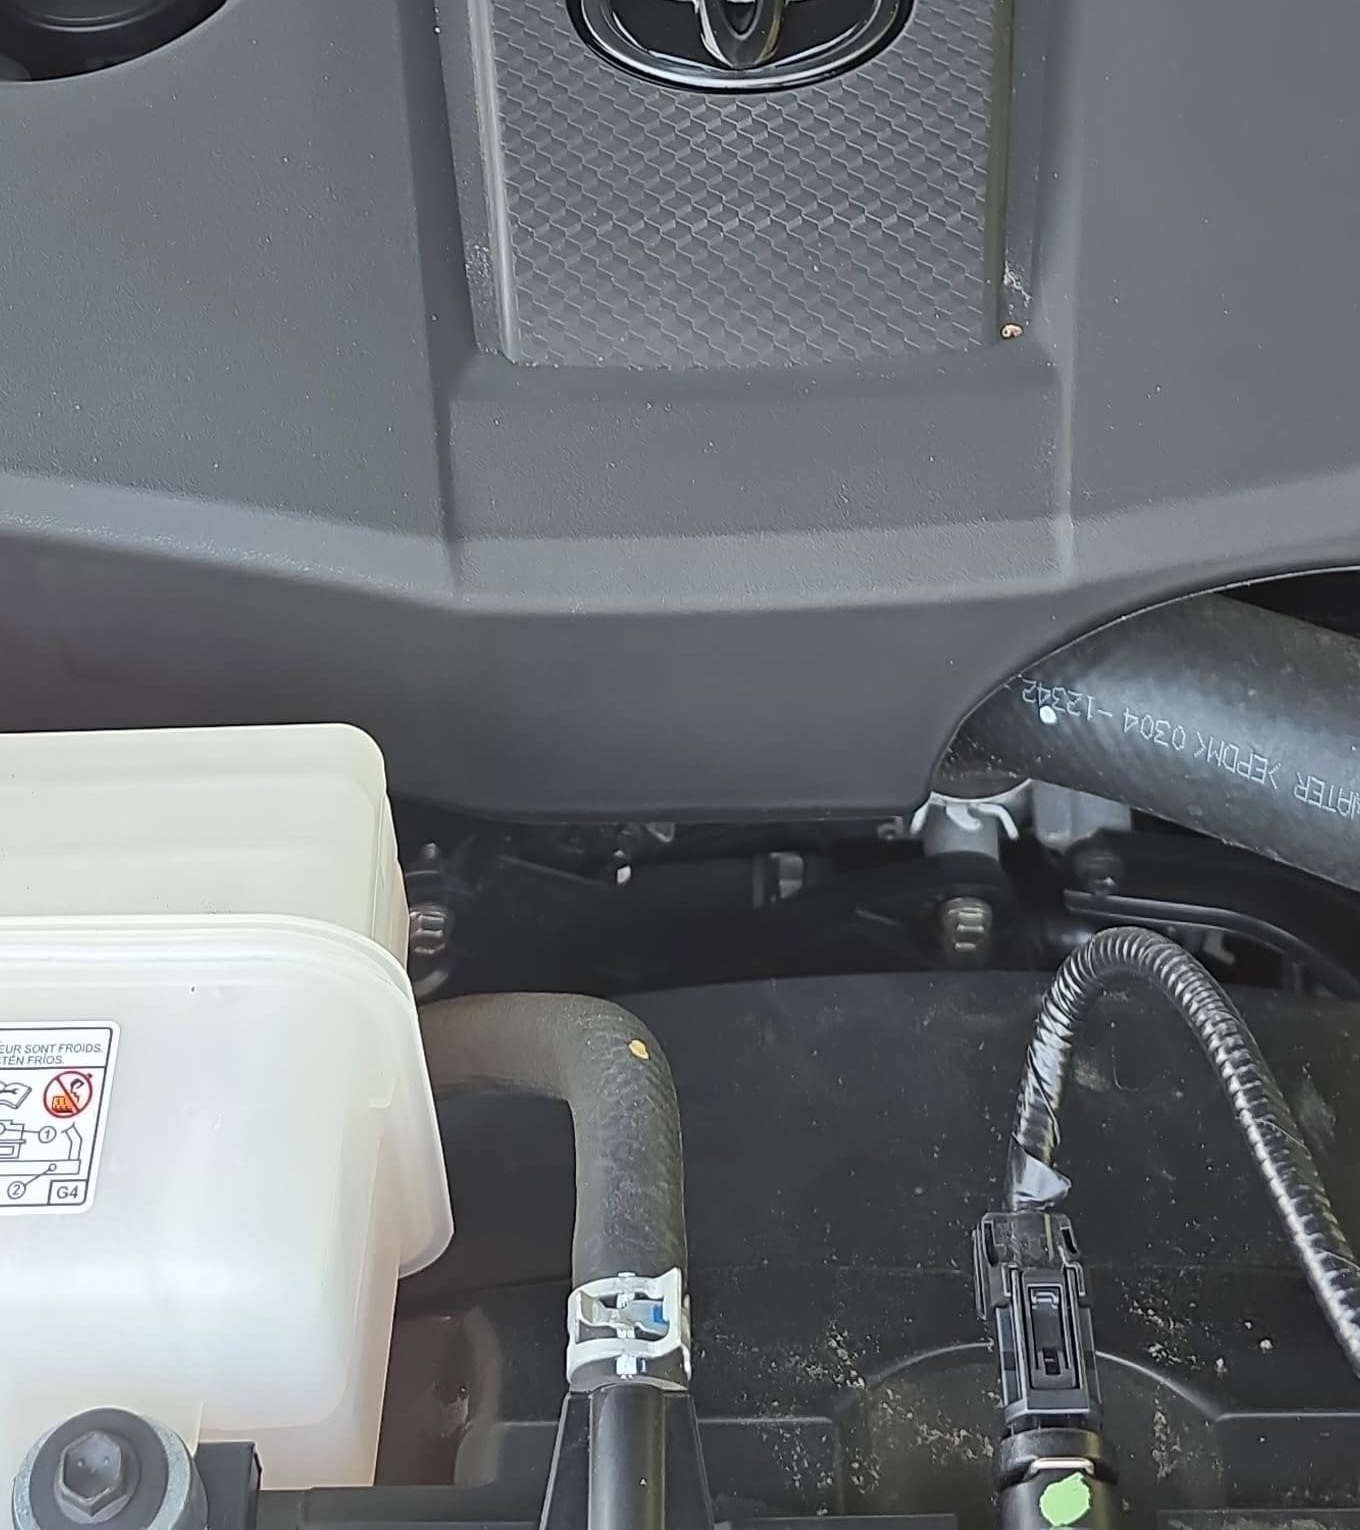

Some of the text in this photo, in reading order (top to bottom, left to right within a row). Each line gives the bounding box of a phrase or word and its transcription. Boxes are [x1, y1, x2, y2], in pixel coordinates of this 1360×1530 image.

[1123, 708, 1186, 752] 0304
[22, 1044, 55, 1054] SONT
[57, 1043, 105, 1053] FROIDS.
[55, 1184, 79, 1199] G4
